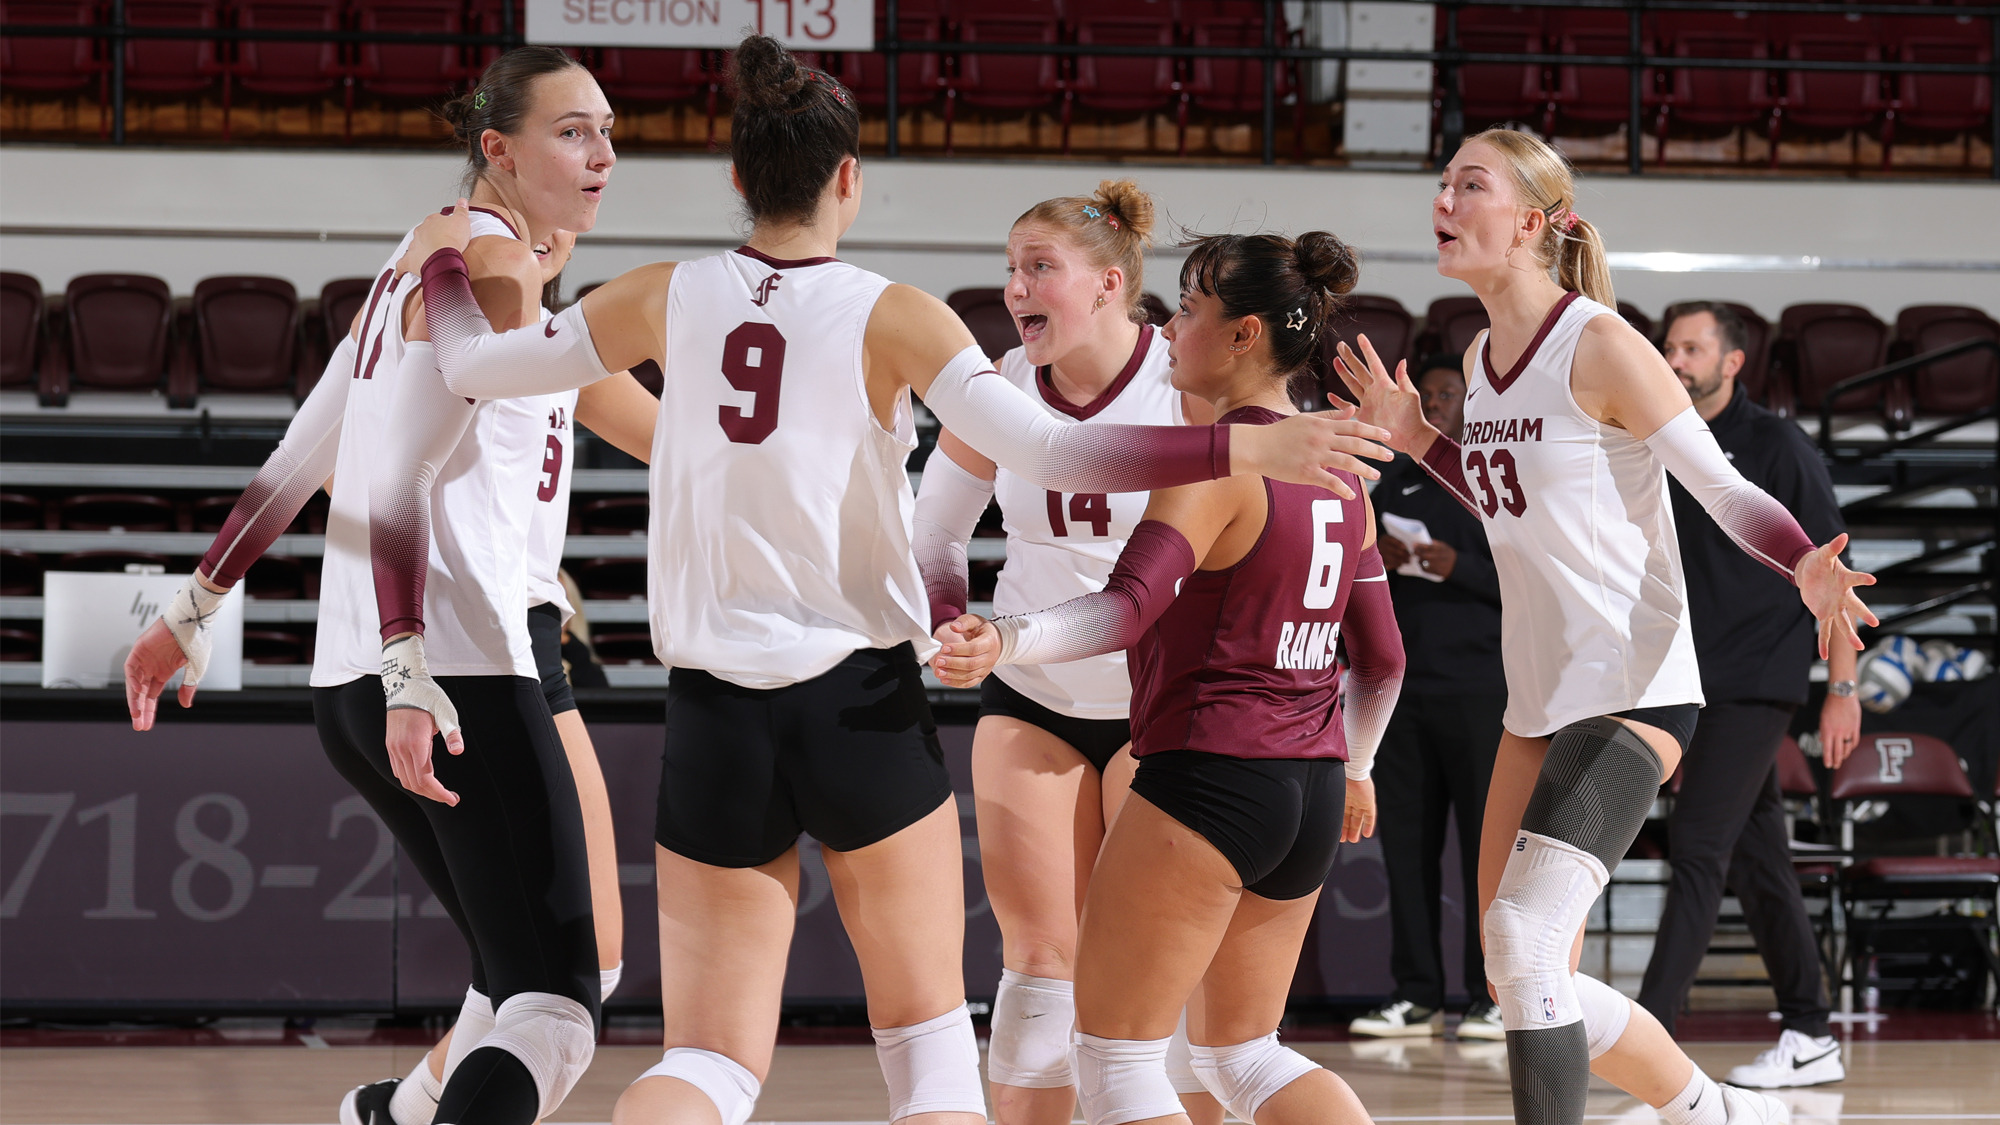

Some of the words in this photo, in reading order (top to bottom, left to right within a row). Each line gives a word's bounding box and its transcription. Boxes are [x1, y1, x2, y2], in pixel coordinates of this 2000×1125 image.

[562, 0, 720, 26] SECTION
[746, 0, 837, 40] 113
[719, 321, 787, 445] 9
[1463, 417, 1544, 446] ORDHAM
[537, 434, 563, 503] 9
[1466, 448, 1527, 519] 33
[1043, 487, 1112, 538] 14
[1303, 499, 1344, 610] 6
[1274, 621, 1341, 670] RAMS
[1875, 738, 1913, 783] F
